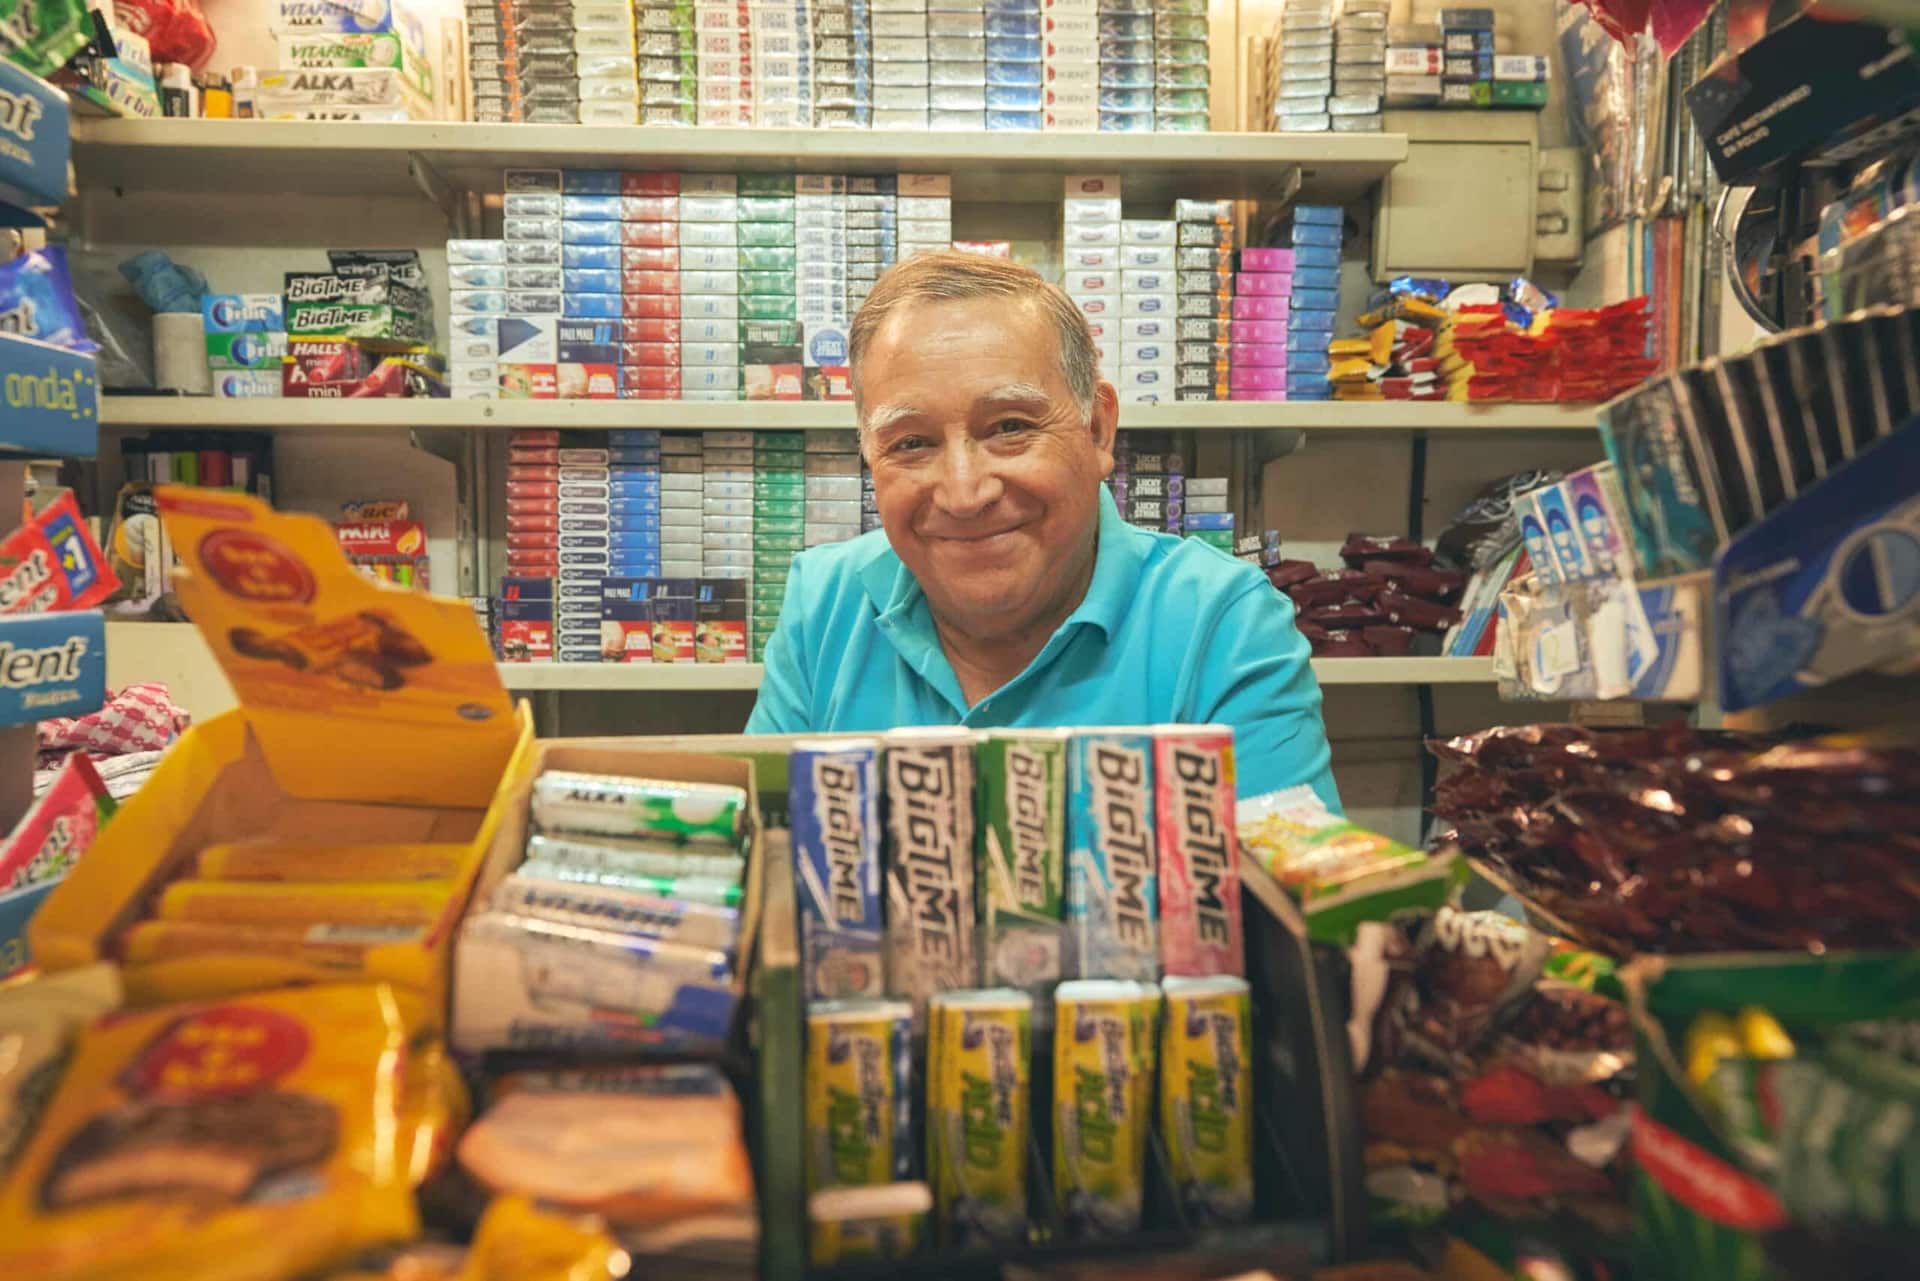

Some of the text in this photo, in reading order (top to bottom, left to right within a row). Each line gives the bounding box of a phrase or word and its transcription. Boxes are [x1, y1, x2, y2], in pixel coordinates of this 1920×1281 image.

[289, 17, 323, 26] ALKA
[300, 59, 334, 68] ALKA
[292, 75, 354, 90] ALKA
[293, 343, 342, 355] HALLS
[338, 522, 391, 541] mini
[565, 788, 626, 805] ALKA
